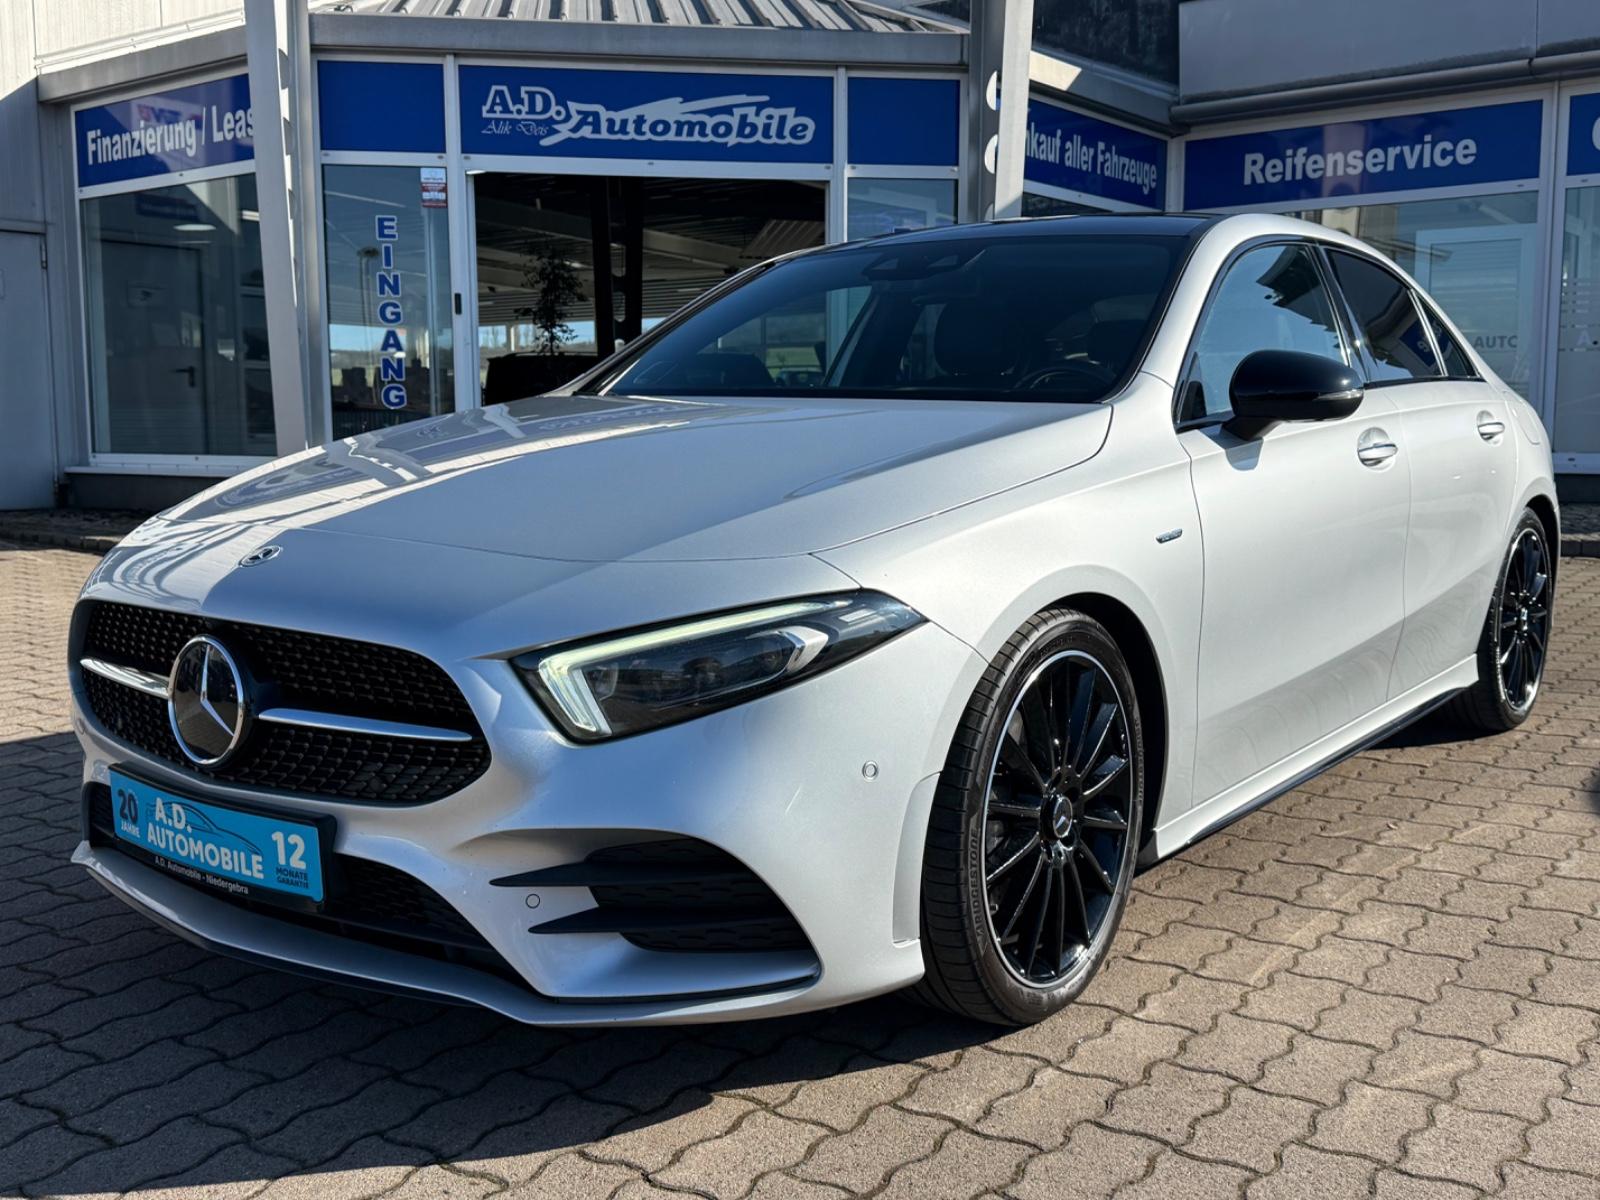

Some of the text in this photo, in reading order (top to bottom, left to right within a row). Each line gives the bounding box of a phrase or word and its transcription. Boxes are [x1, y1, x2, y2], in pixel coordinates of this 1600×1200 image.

[482, 85, 816, 147] A.D. Automobile
[87, 119, 197, 166] Finanzierung
[1065, 133, 1094, 173] aller
[1097, 141, 1158, 196] Fahrzeuge
[1243, 134, 1478, 186] Reifenservice
[375, 214, 408, 411] EINGANG
[117, 788, 138, 825] 20
[155, 797, 192, 833] A.D.
[147, 822, 264, 879] AUTOMOBILE
[271, 831, 306, 870] 12
[275, 867, 308, 881] MONATE
[167, 860, 201, 881] Automobile
[206, 873, 249, 895] Niedergebra
[968, 827, 985, 938] BRIDGESTONE
